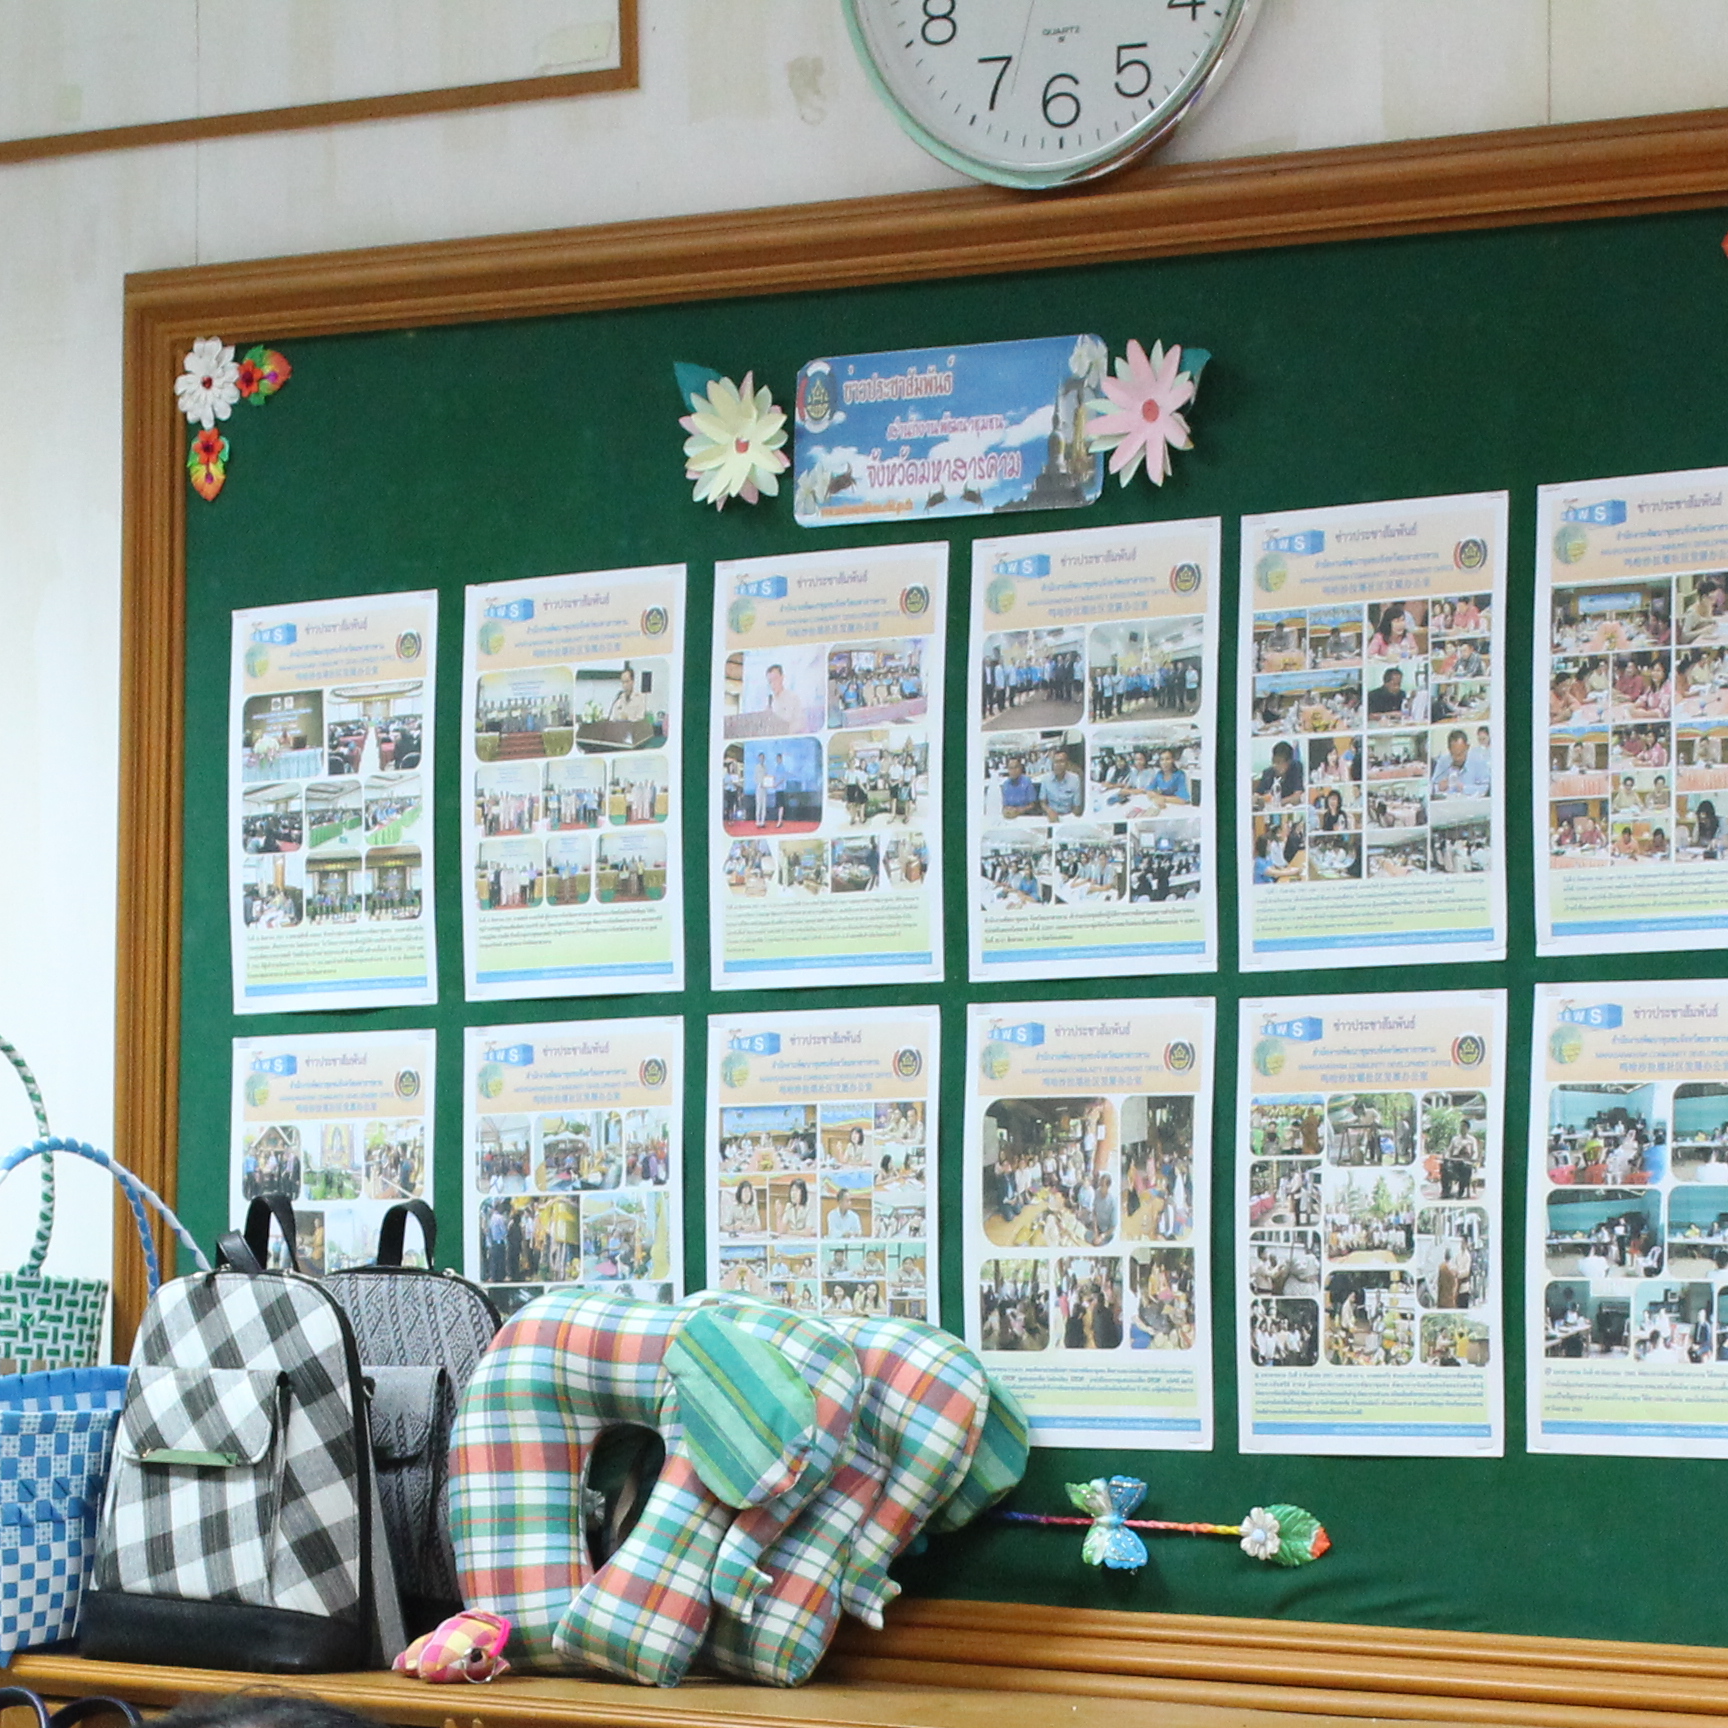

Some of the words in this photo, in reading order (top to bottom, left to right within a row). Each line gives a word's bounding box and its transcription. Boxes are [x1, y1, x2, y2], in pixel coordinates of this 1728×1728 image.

[921, 0, 959, 46] 8
[978, 56, 1013, 111] 7
[1114, 43, 1151, 98] 5
[1041, 73, 1081, 128] 6
[843, 354, 956, 405] ข่าวประชาสัมพันธ์
[867, 446, 1022, 488] จังหวัดมหาสารคาม
[1334, 1015, 1416, 1032] ข่าวประชาสัมพันธ์
[1633, 1002, 1718, 1019] ข่าวประชาสัมพันธ์
